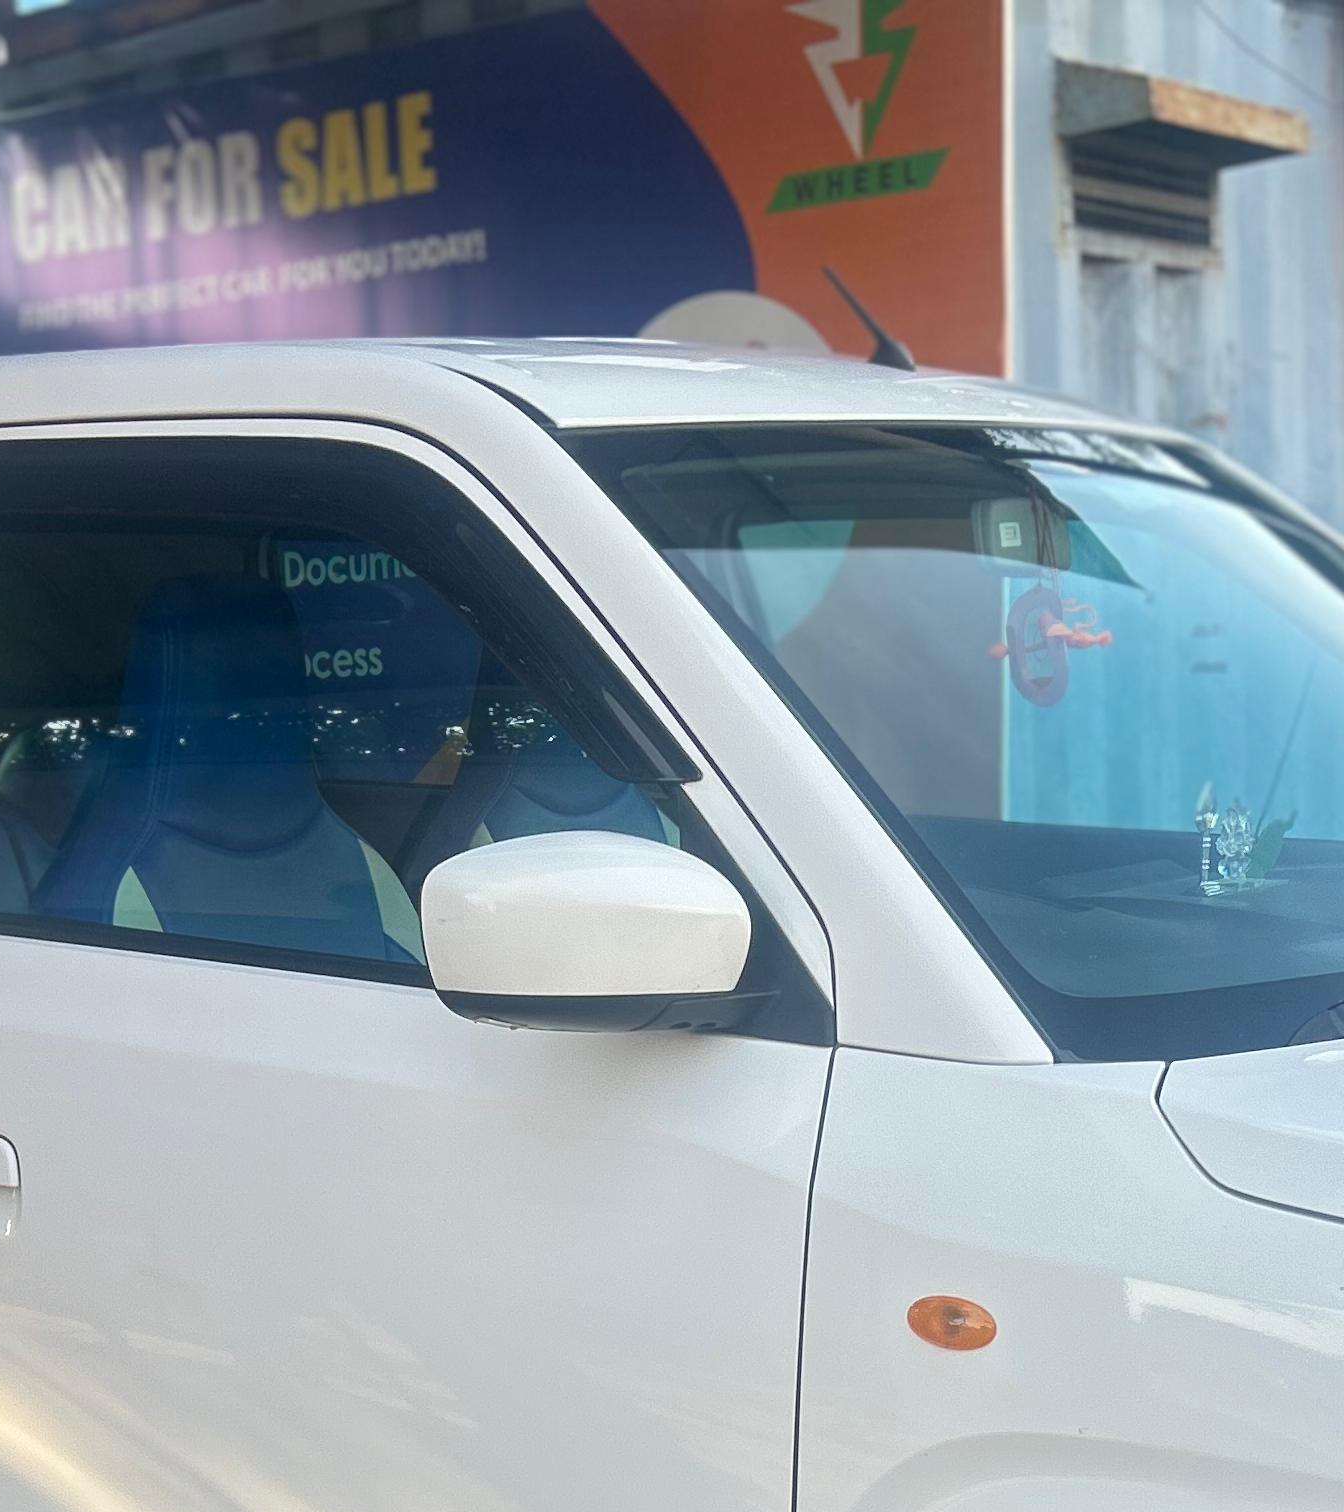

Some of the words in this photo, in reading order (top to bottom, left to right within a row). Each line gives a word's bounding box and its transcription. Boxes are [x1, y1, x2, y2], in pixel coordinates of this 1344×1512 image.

[11, 156, 131, 265] CAR
[143, 130, 263, 242] FOR
[276, 91, 438, 219] SALE
[791, 159, 917, 204] WHEEL
[278, 255, 331, 294] FOR
